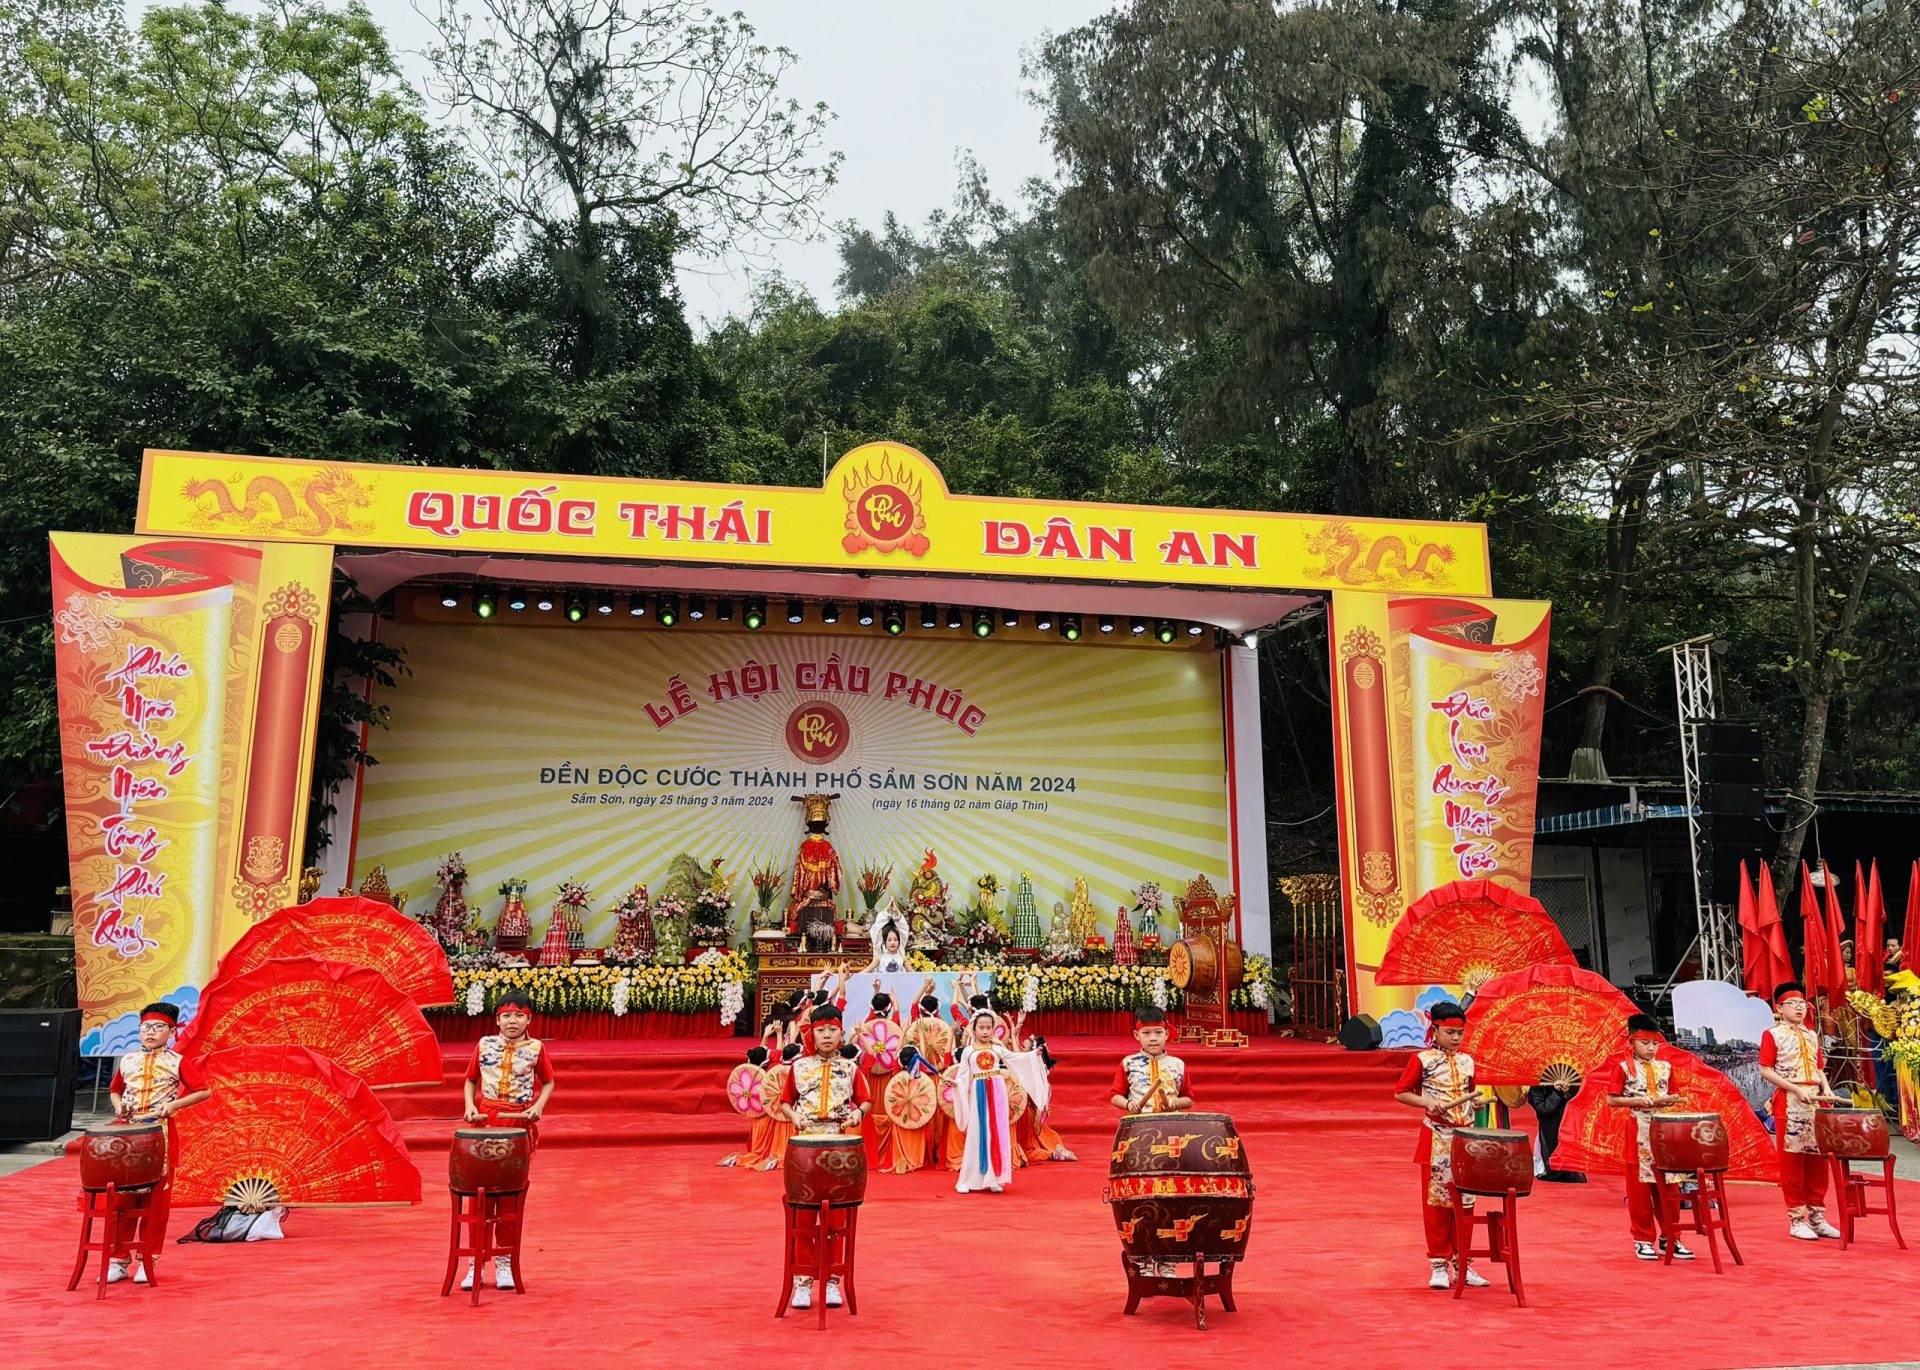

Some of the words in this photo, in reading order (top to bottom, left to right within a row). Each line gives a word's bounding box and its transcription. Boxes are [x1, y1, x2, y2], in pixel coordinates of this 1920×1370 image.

[407, 485, 597, 538] QUỐC
[617, 499, 773, 545] THÁI
[980, 516, 1136, 564] DÂN
[1157, 530, 1260, 570] AN
[105, 645, 192, 684] Phúc
[119, 685, 175, 730] Mãn
[642, 673, 698, 731] LỄ
[707, 659, 780, 703] HỘI
[795, 652, 871, 695] CẦU
[884, 669, 988, 737] PHÚC
[1430, 691, 1495, 719] Đức
[88, 732, 198, 776] Đường
[113, 766, 168, 814] Niên
[539, 761, 589, 784] ĐỀN
[597, 764, 648, 788] ĐỘC
[656, 766, 722, 787] CƯỚC
[729, 767, 806, 787] THÀNH
[815, 766, 862, 788] PHỐ
[868, 767, 915, 789] SẦM
[923, 773, 968, 790] SƠN
[976, 772, 1022, 792] NĂM
[1029, 776, 1077, 793] 2024
[1432, 763, 1510, 806] Quang
[599, 793, 625, 805] Sơn,
[628, 793, 657, 807] ngày
[659, 794, 674, 805] 25
[676, 794, 709, 808] tháng
[711, 795, 719, 806] 3
[721, 795, 745, 806] năm
[747, 796, 774, 806] 2024
[871, 798, 902, 811] (ngày
[905, 798, 918, 809] 16
[920, 798, 951, 812] tháng
[953, 799, 966, 809] 02
[968, 800, 991, 810] năm
[994, 799, 1019, 812] Giáp
[1444, 799, 1501, 842] Nhật
[101, 815, 171, 862] Tăng
[1452, 842, 1497, 878] Tiến
[95, 864, 166, 904] Phú
[93, 907, 158, 956] Quý
